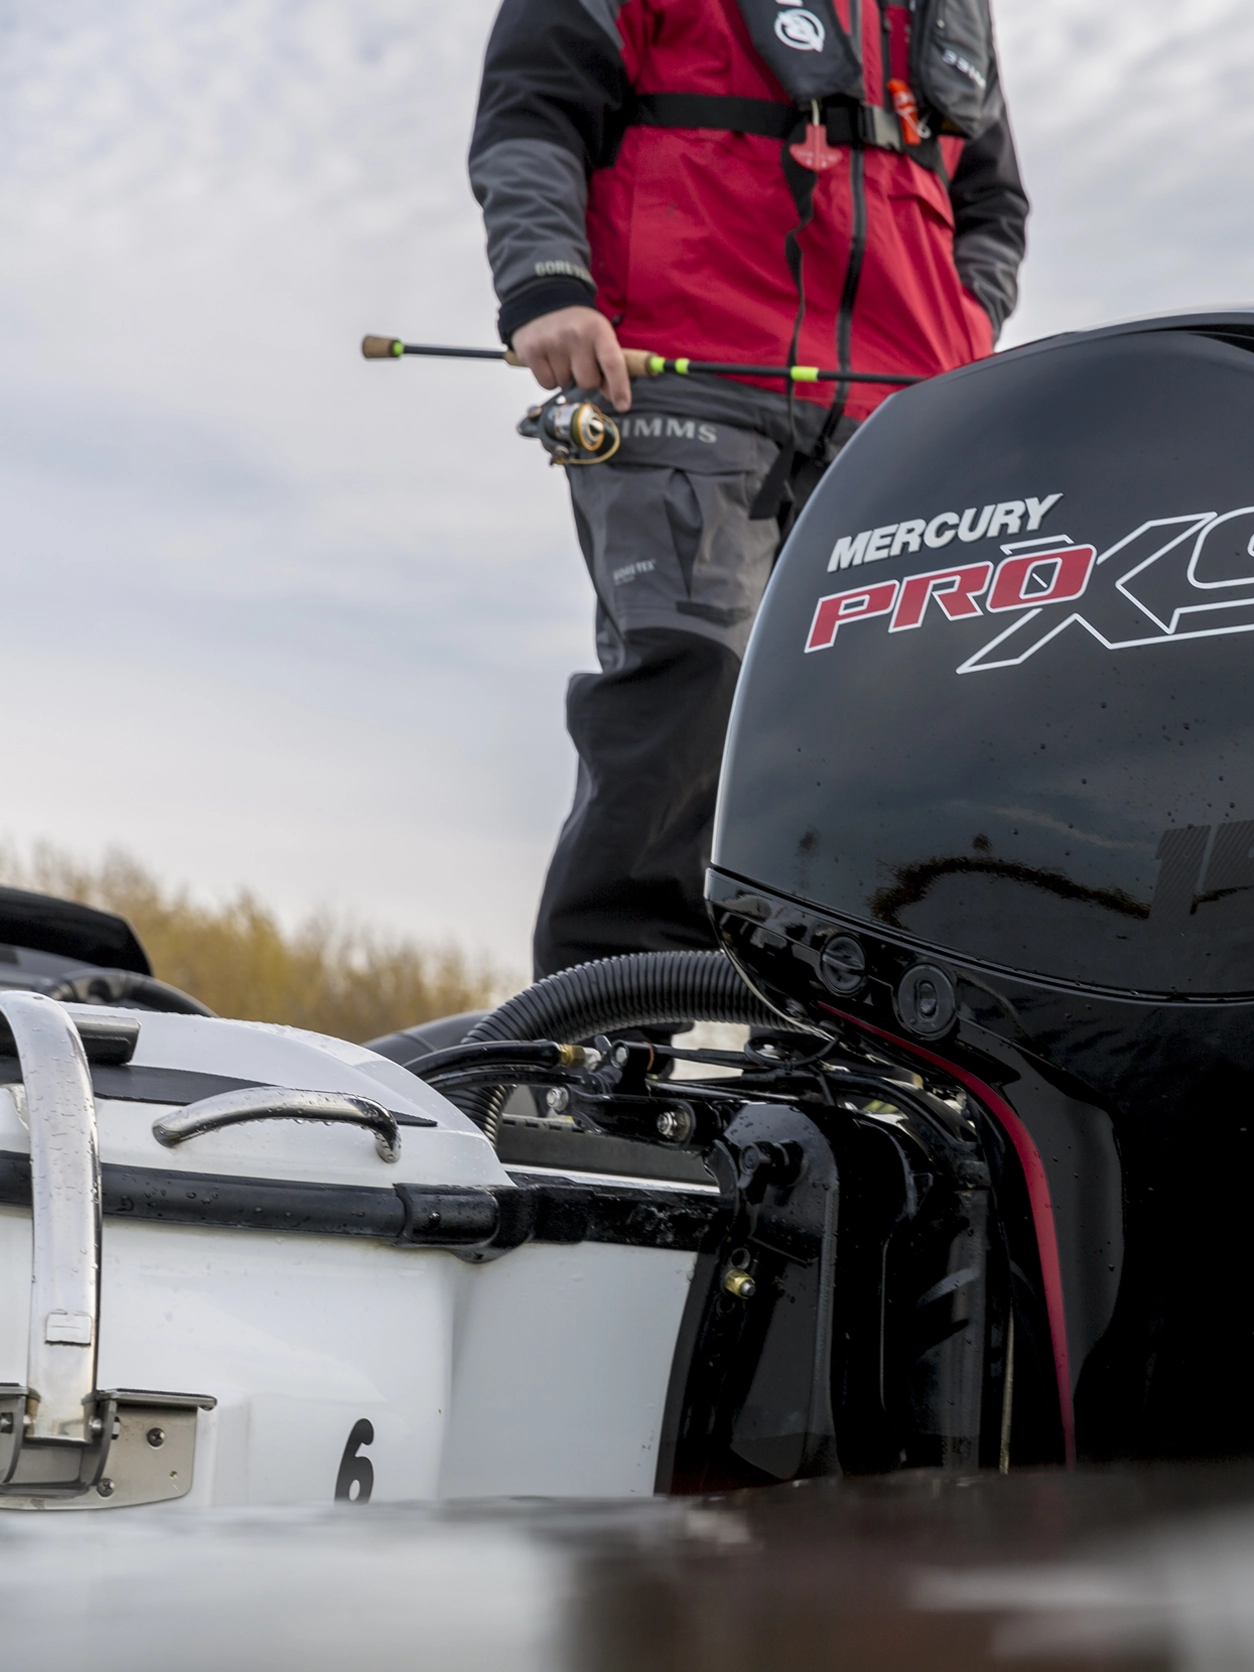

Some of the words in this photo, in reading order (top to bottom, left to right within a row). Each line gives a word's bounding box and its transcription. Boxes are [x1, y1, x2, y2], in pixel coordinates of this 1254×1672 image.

[827, 493, 1063, 573] MERCURY
[804, 544, 1097, 653] PRO
[333, 1418, 374, 1505] 6
